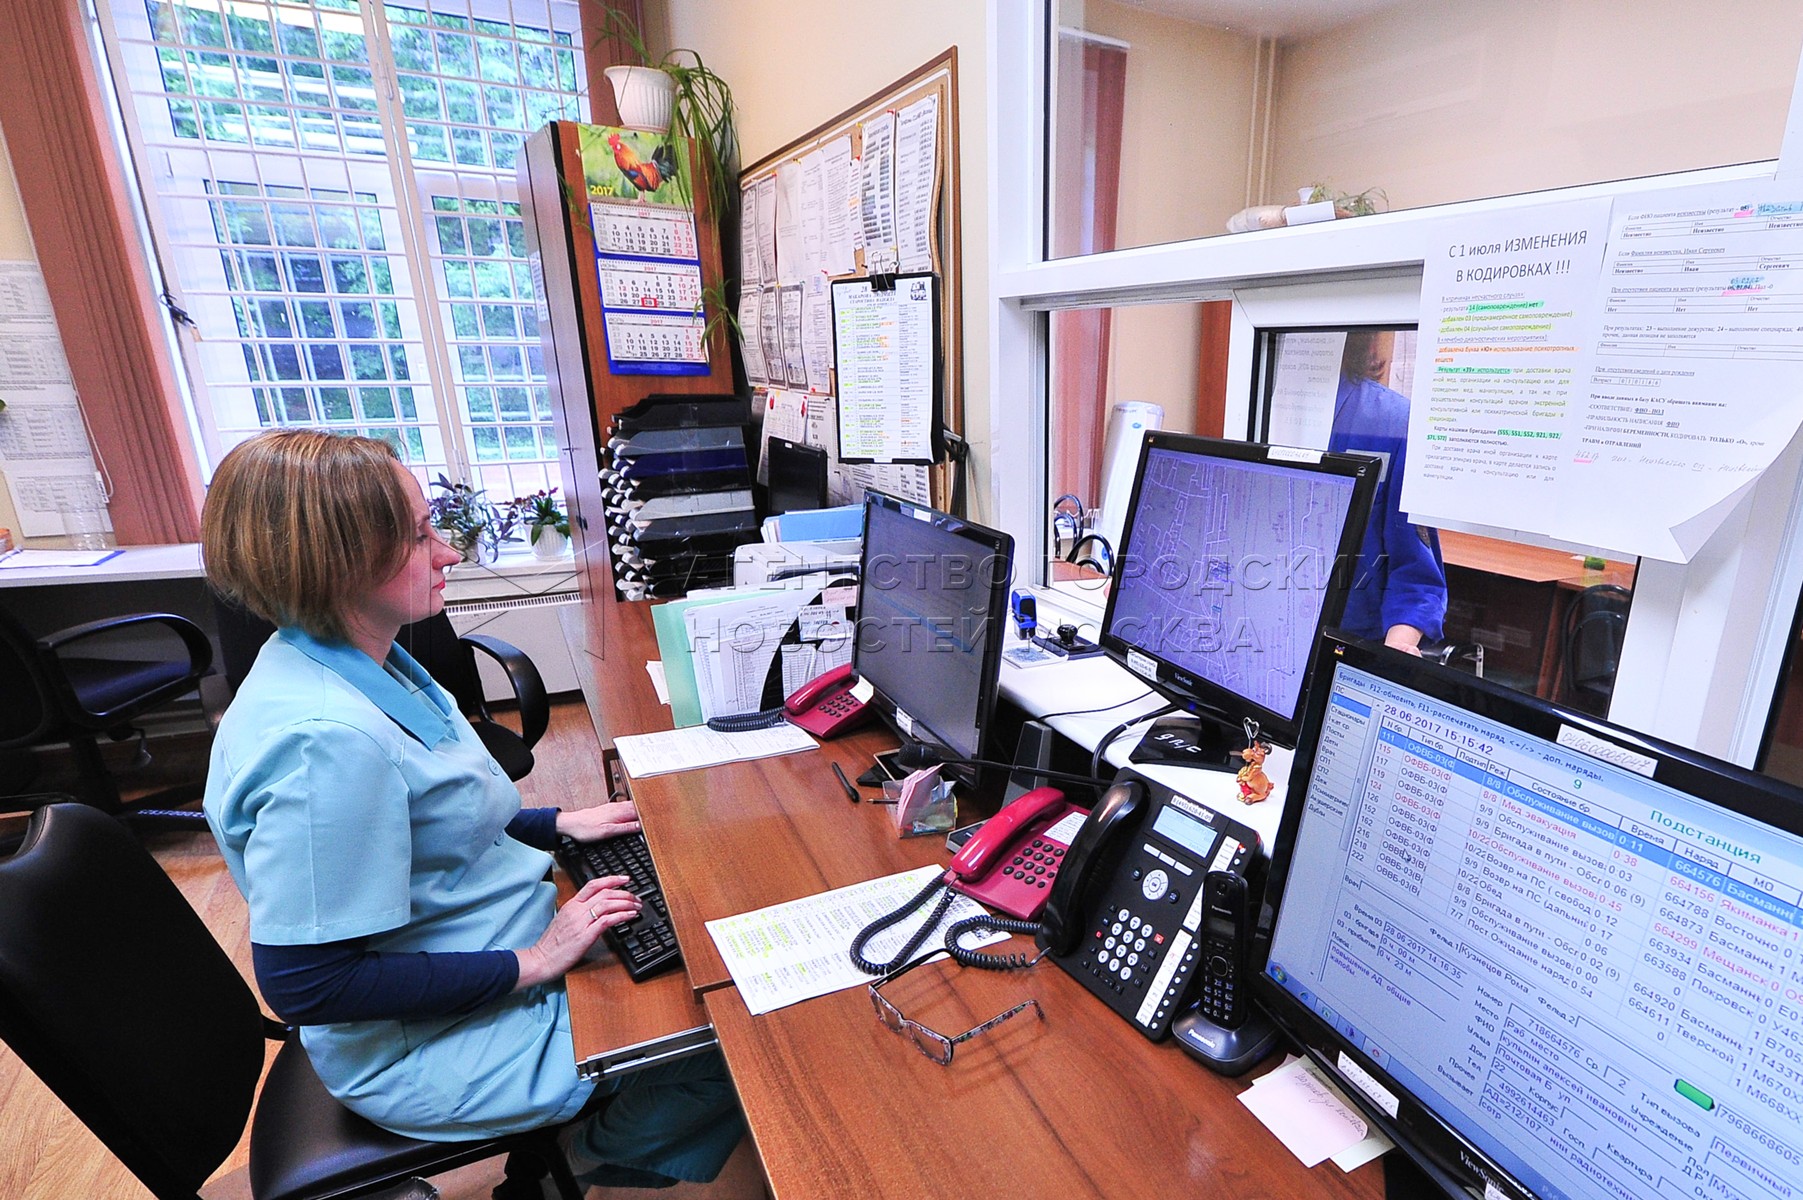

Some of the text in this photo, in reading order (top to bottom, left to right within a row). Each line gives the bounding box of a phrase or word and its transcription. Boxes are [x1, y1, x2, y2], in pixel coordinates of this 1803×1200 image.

[590, 185, 614, 196] 2017
[1449, 230, 1587, 258] С 1 июля ИЗМЕНЕНИЯ
[1456, 260, 1571, 283] В КОДИРОВКАХ !!!
[1339, 671, 1366, 688] Бригады
[1418, 702, 1479, 733] F11-распечатать
[1384, 704, 1494, 756] 28.06.2017 15:15:42
[1378, 743, 1392, 754] 115
[1669, 875, 1716, 903] 664156
[1719, 899, 1789, 937] Якиманка
[1381, 731, 1722, 887] 111 8/8 Обслуживание 664576
[1531, 781, 1578, 808] Состояние
[1630, 824, 1665, 845] Время
[1684, 847, 1719, 870] Наряд
[1753, 876, 1775, 892] МО
[1573, 779, 1762, 864] 9 Подстанция
[1351, 850, 1464, 920] 222 7/7
[1361, 815, 1374, 827] 162
[1479, 880, 1503, 900] Обед
[1369, 779, 1383, 791] 124
[1490, 840, 1561, 881] Обслуживание
[1653, 922, 1699, 950] 664299
[1375, 755, 1779, 952] 117 9/9 Обслуживание 664788 Восточно
[1475, 817, 1490, 830] 9/9
[1494, 826, 1533, 851] Бригада
[1544, 852, 1567, 868] пути
[1630, 893, 1646, 908] (9)
[1659, 907, 1704, 935] 664873
[1356, 827, 1676, 1011] 216 Бригада пути (9) 664920
[1363, 803, 1755, 1018] 152 663588 Покровск
[1331, 944, 1370, 976] повышение
[1353, 839, 1735, 1064] 218 664611 Тверской
[1462, 946, 1529, 994] Кузнецов Рома
[1649, 937, 1692, 965] 663934
[1474, 1000, 1560, 1062] Место место
[1477, 985, 1504, 1007] Номер
[1528, 1018, 1580, 1059] 718664576
[1618, 1078, 1627, 1088] 2
[1498, 1048, 1542, 1084] Почтовая
[1437, 1065, 1474, 1096] Вызывает
[1481, 1101, 1502, 1120] сотр
[1448, 1056, 1476, 1081] Прочее
[1474, 1014, 1495, 1033] ФИО
[1542, 1063, 1584, 1096] алексей
[1586, 1093, 1638, 1133] иванович
[1468, 1043, 1653, 1182] Дом 22 Корпус Квартира
[1630, 1104, 1694, 1152] Учреждение
[1640, 1092, 1792, 1197] Тип вызова Первичный
[1720, 1109, 1801, 1166] 7968668605
[1687, 1156, 1710, 1177] Пол
